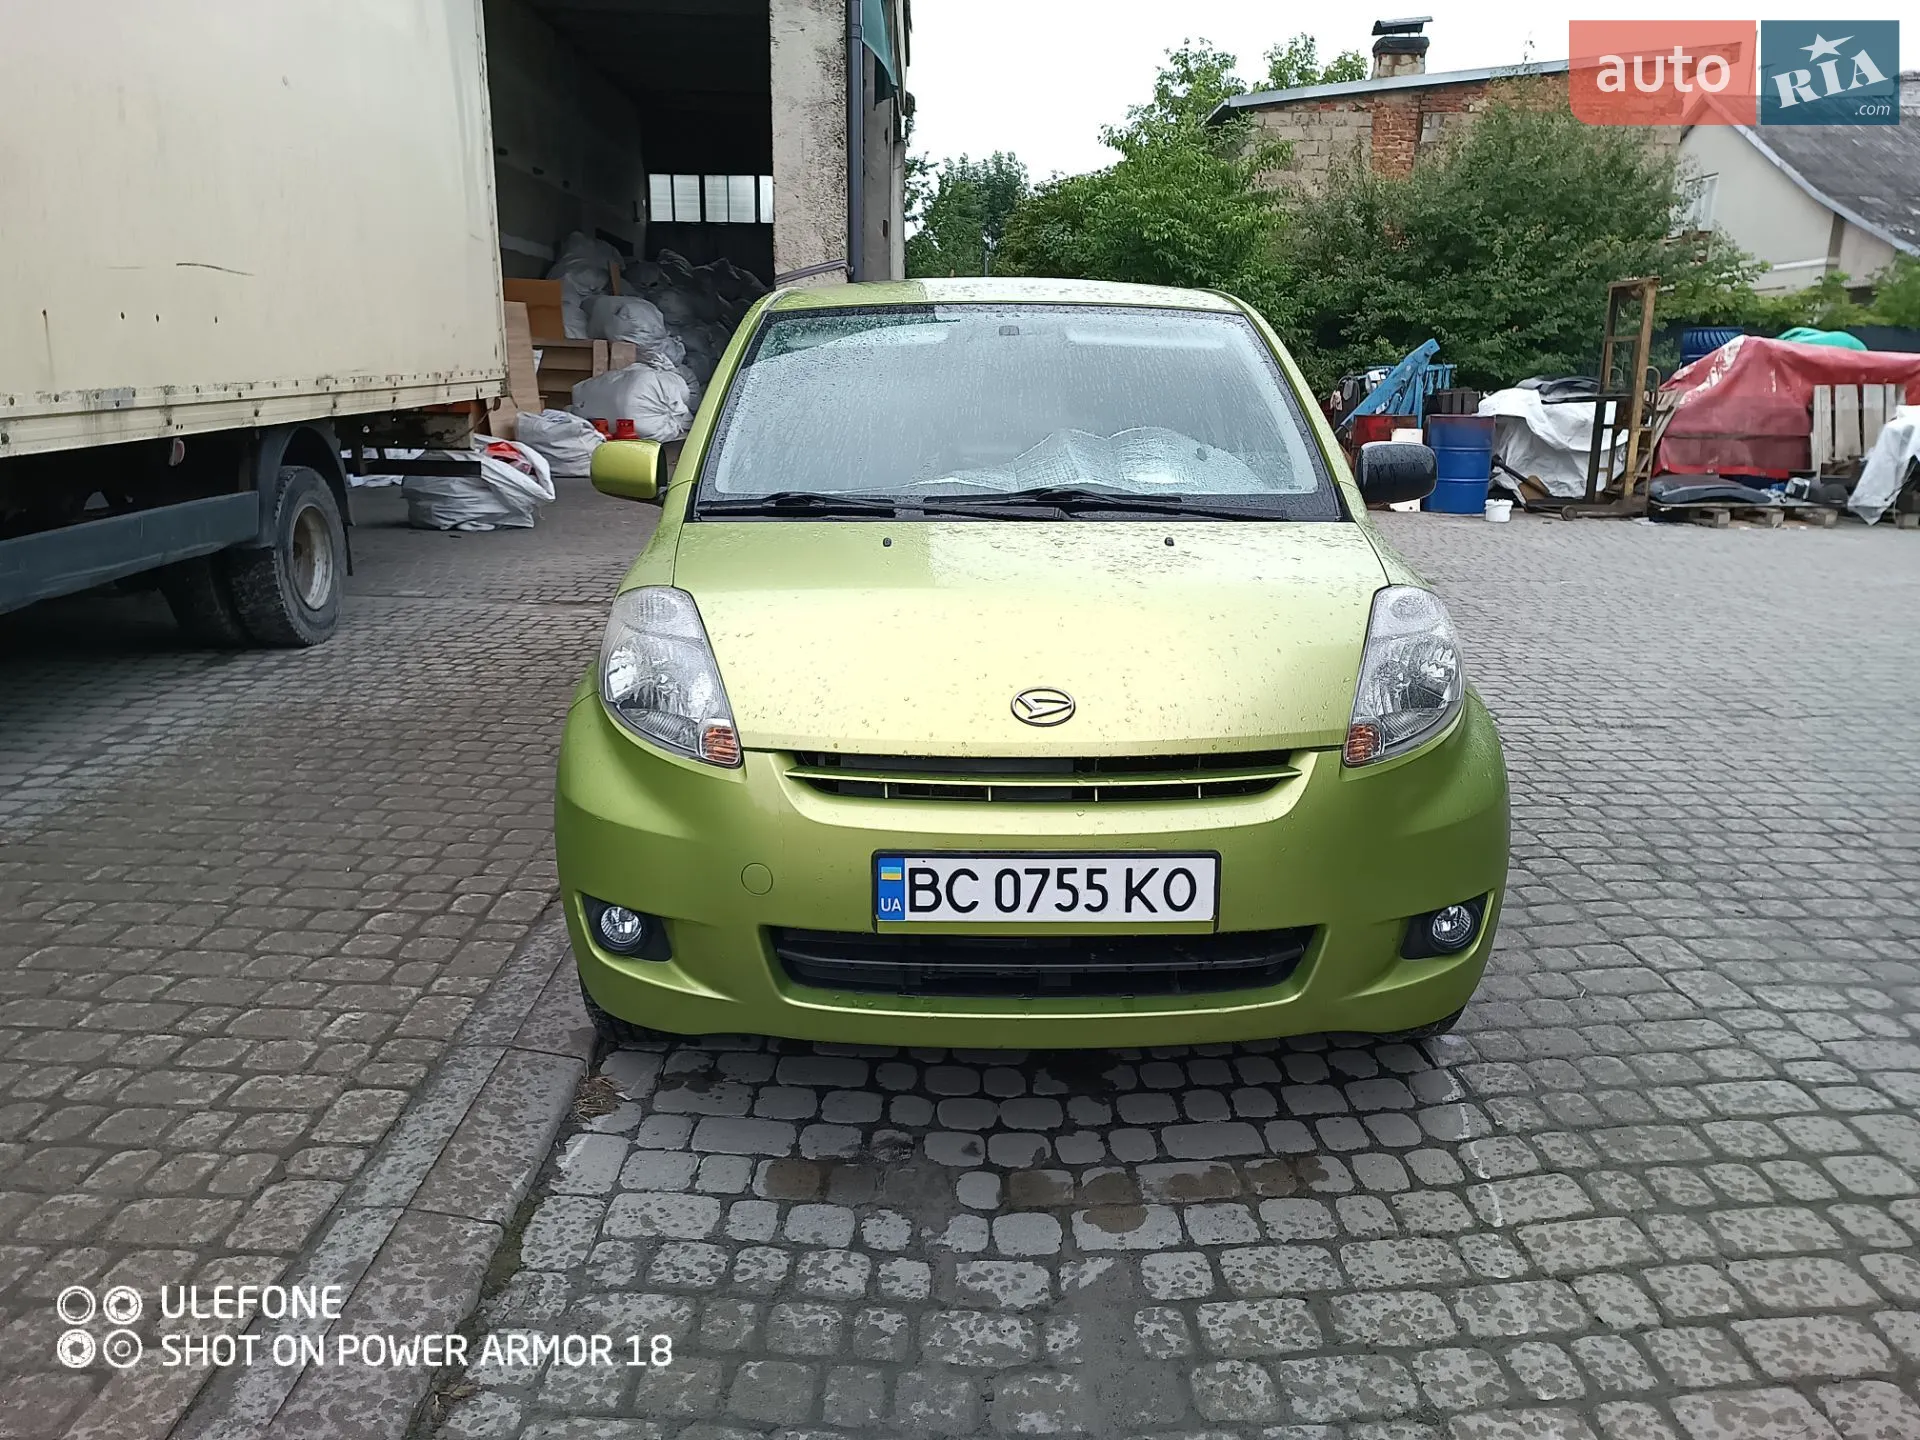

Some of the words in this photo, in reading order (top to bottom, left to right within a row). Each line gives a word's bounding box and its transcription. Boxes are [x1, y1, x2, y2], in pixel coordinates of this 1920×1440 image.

[880, 897, 902, 912] UA
[908, 867, 980, 914] BC
[994, 867, 1109, 914] 0755
[1124, 867, 1198, 914] KO
